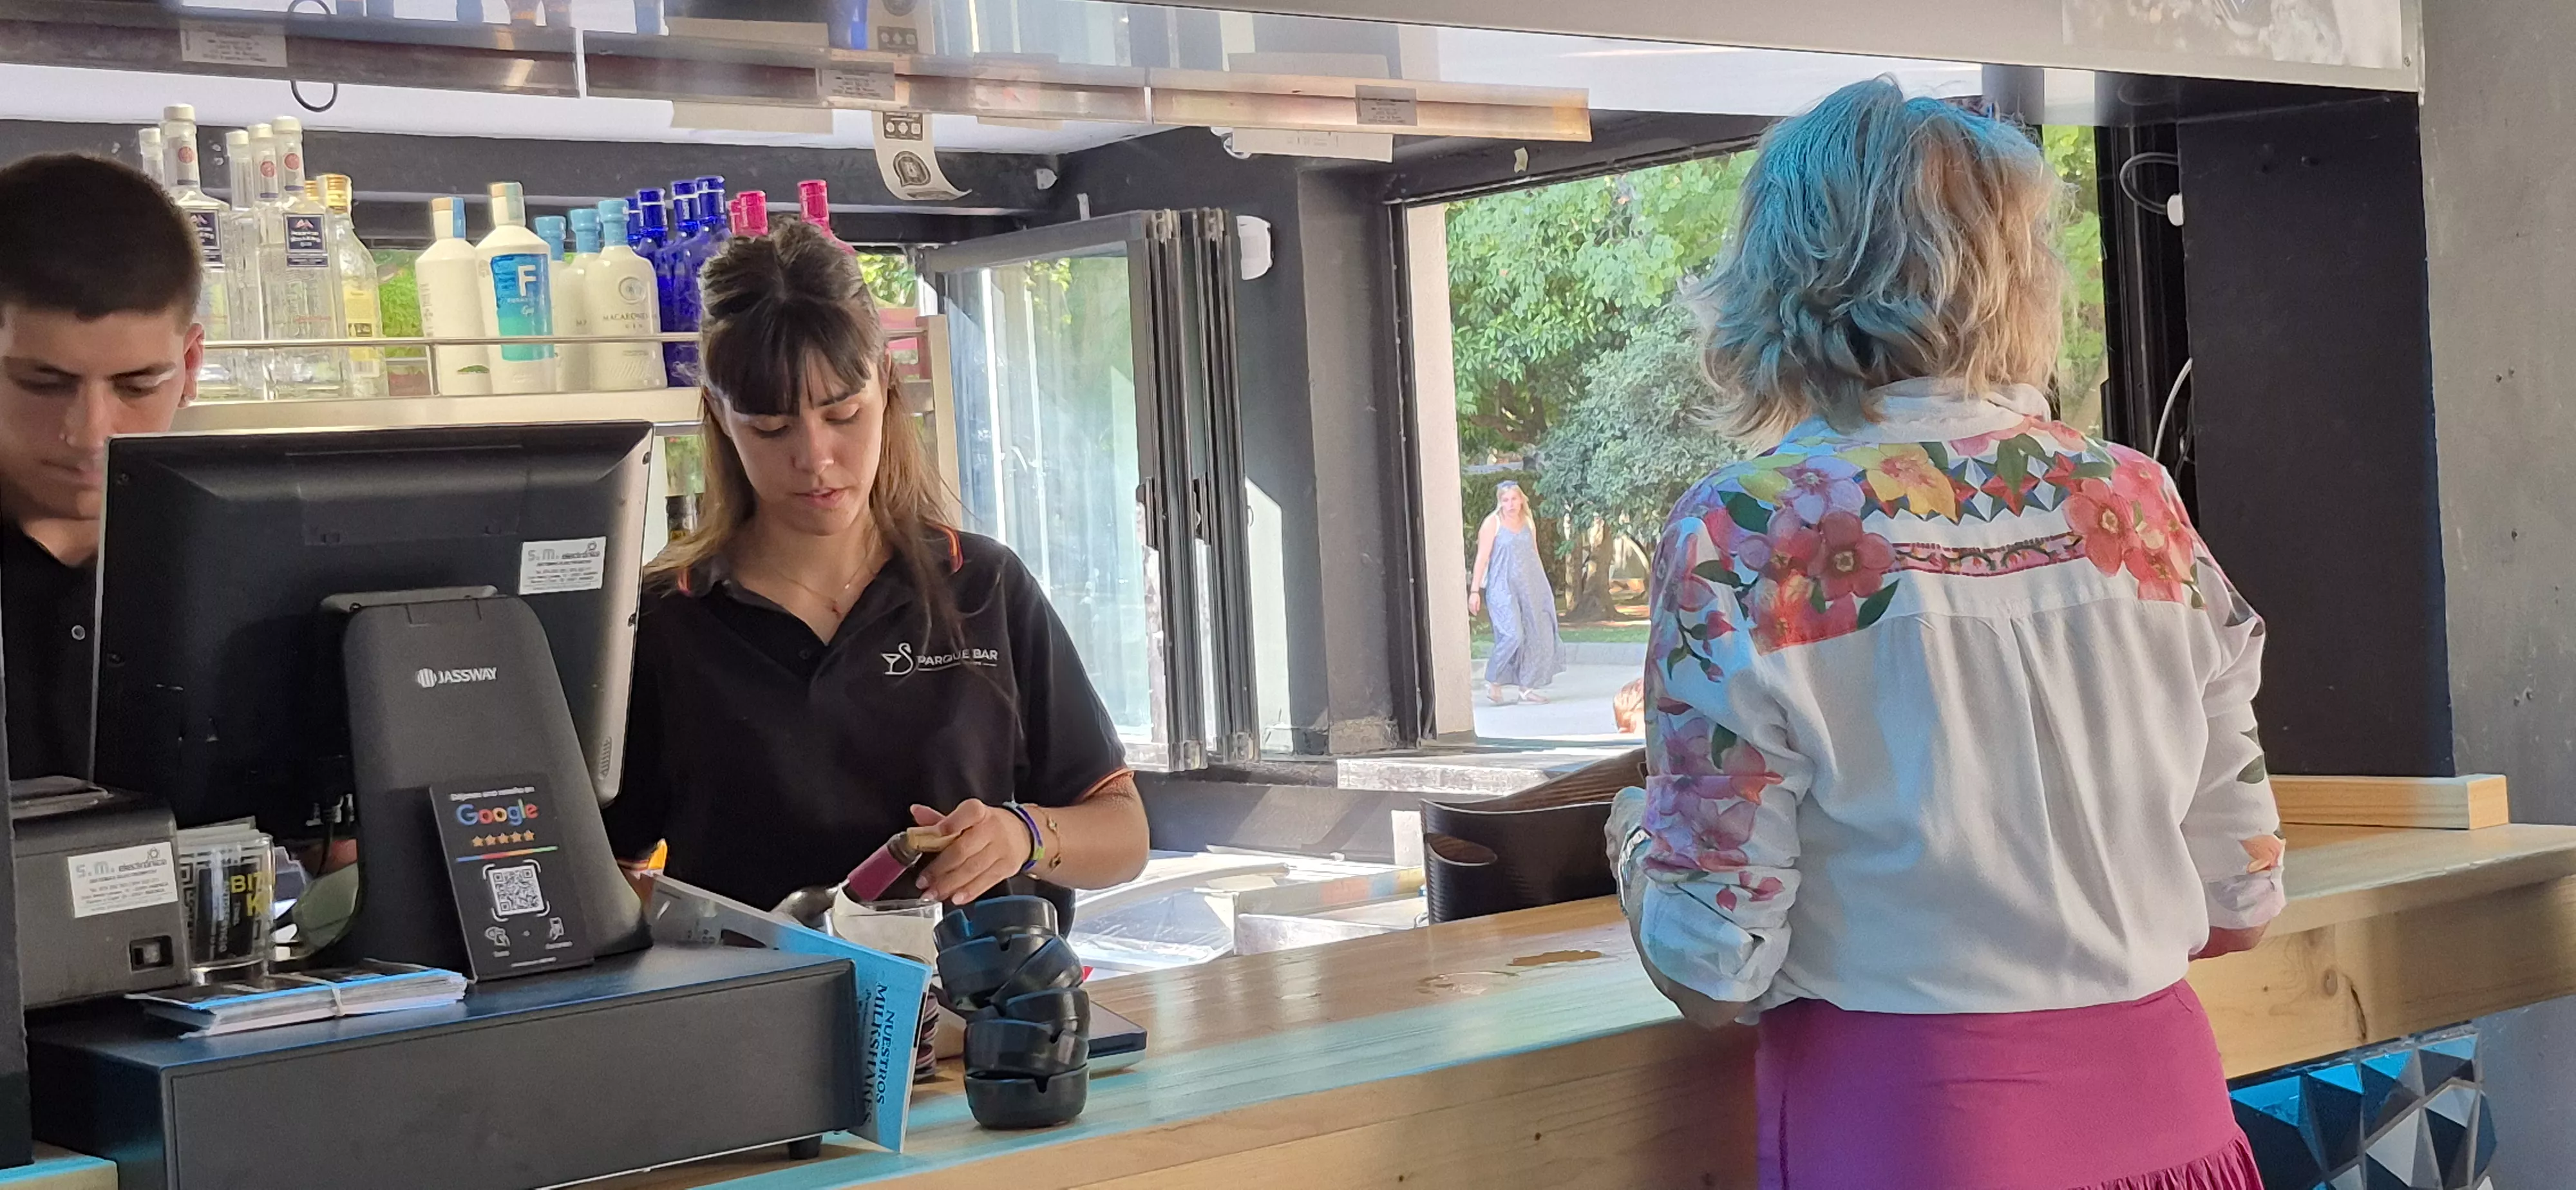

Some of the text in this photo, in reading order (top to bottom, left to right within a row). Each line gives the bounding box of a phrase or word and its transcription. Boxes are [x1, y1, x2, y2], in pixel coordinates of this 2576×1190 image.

[518, 265, 537, 296] F
[917, 649, 970, 666] PARQUE
[973, 648, 998, 660] BAR
[438, 667, 497, 684] JASSWAY
[456, 798, 539, 826] Google
[876, 1010, 895, 1105] NUESTROS
